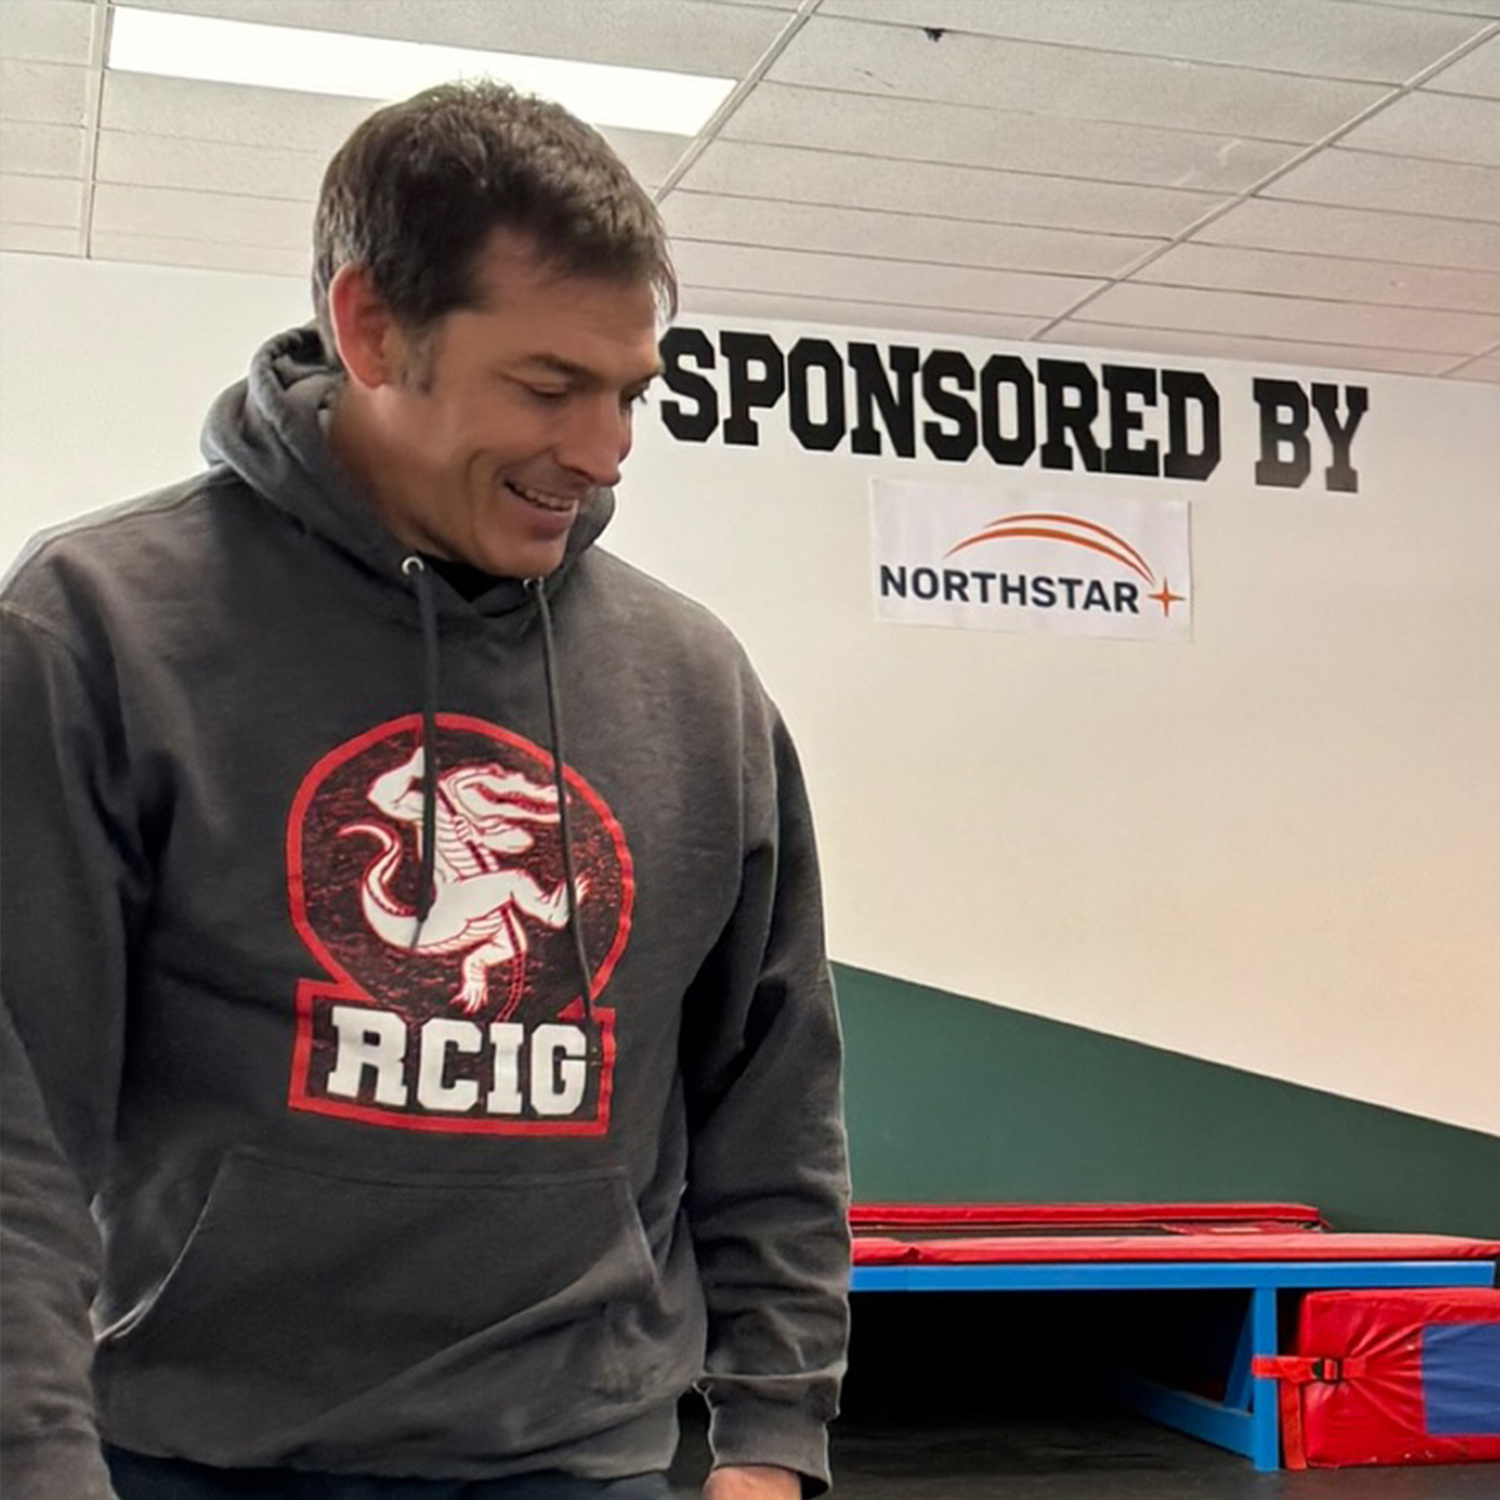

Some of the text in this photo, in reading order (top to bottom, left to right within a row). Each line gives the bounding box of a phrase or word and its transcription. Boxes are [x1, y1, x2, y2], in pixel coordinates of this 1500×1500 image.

[658, 327, 1370, 494] SPONSORED BY
[879, 563, 1140, 615] NORTHSTAR
[326, 1005, 587, 1116] RCIG
